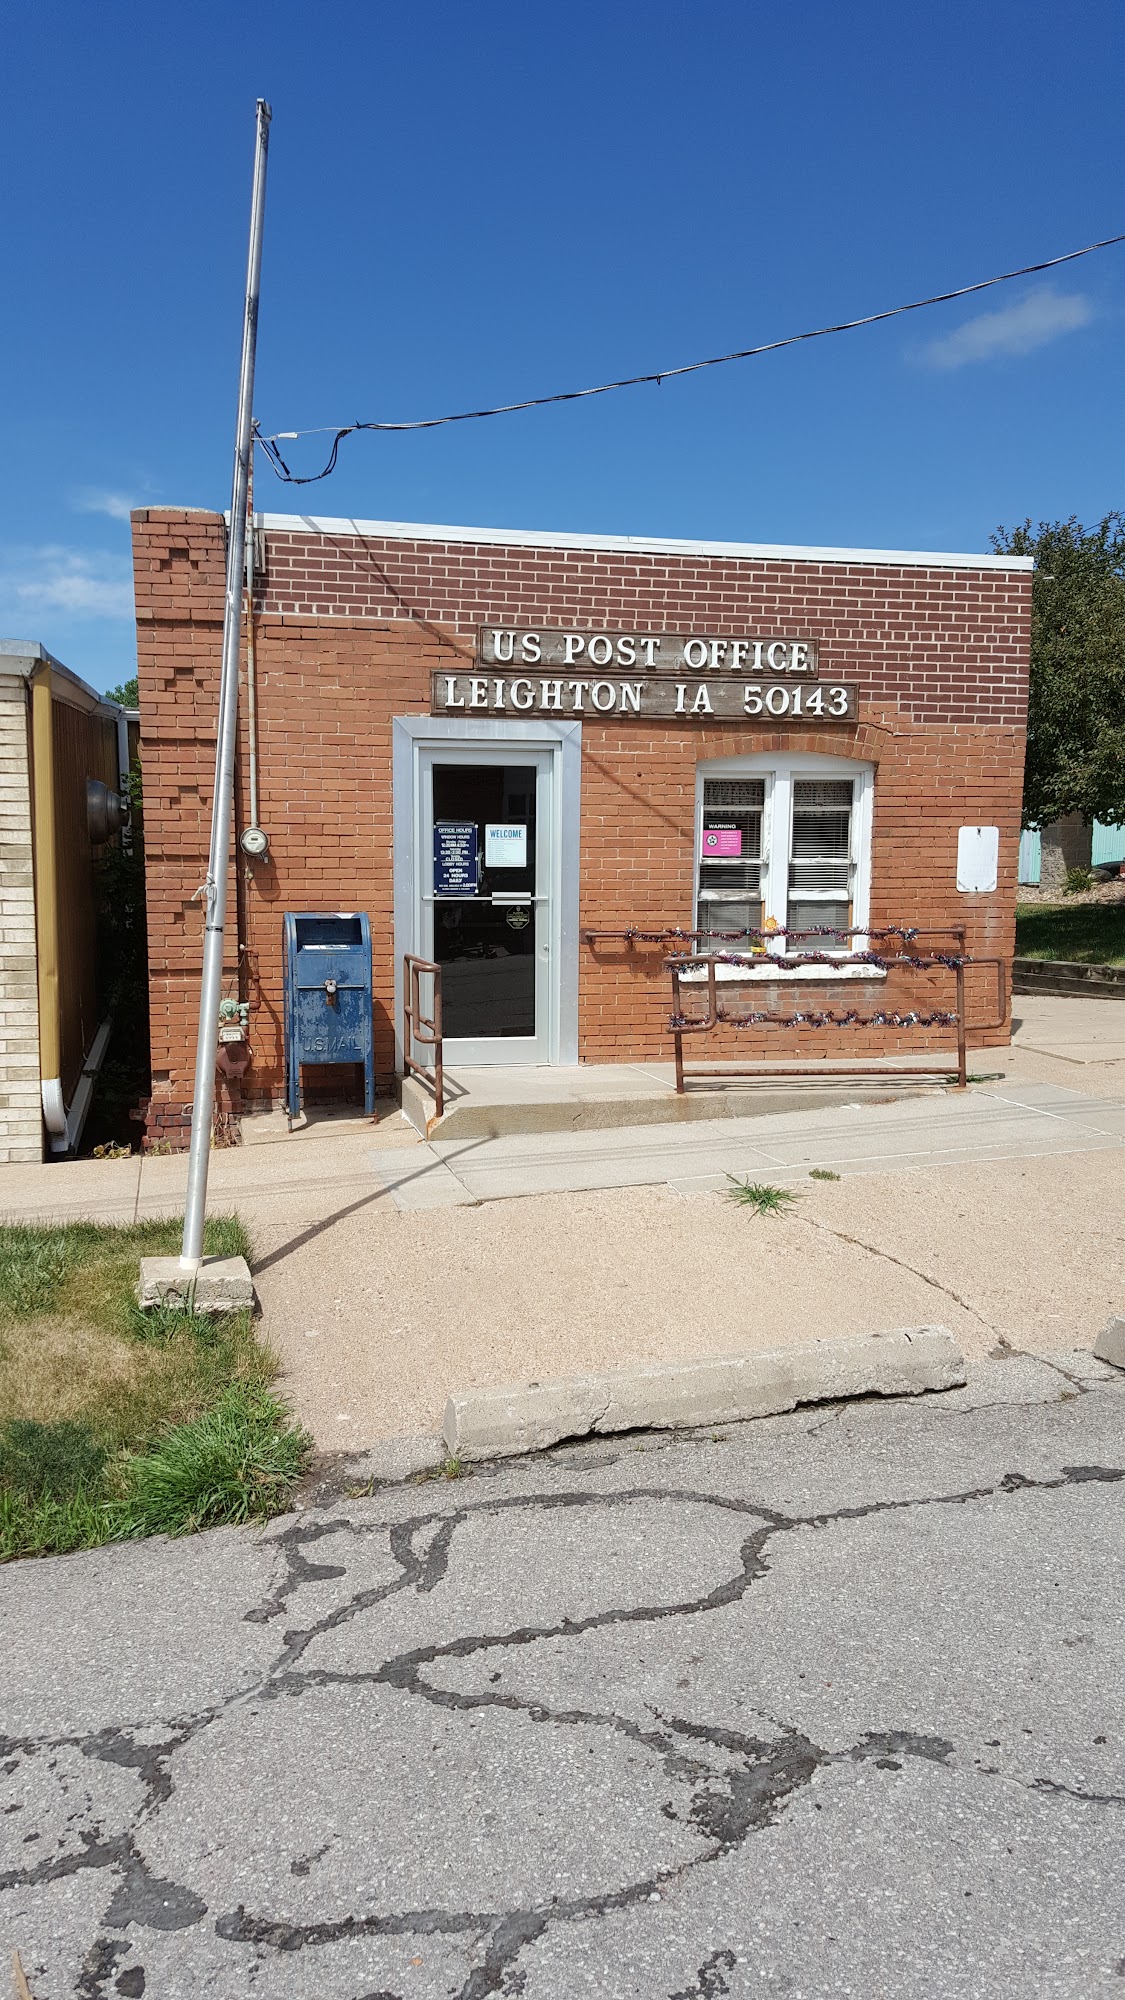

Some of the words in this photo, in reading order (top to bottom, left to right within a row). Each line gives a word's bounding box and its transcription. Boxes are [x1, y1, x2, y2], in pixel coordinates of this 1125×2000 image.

[491, 630, 542, 664] US
[563, 634, 661, 668] POST
[683, 639, 809, 672] OFFICE
[444, 677, 643, 713] LEIGHTON
[674, 683, 714, 714] IA
[743, 686, 849, 716] 50143
[490, 829, 523, 838] WELCOME
